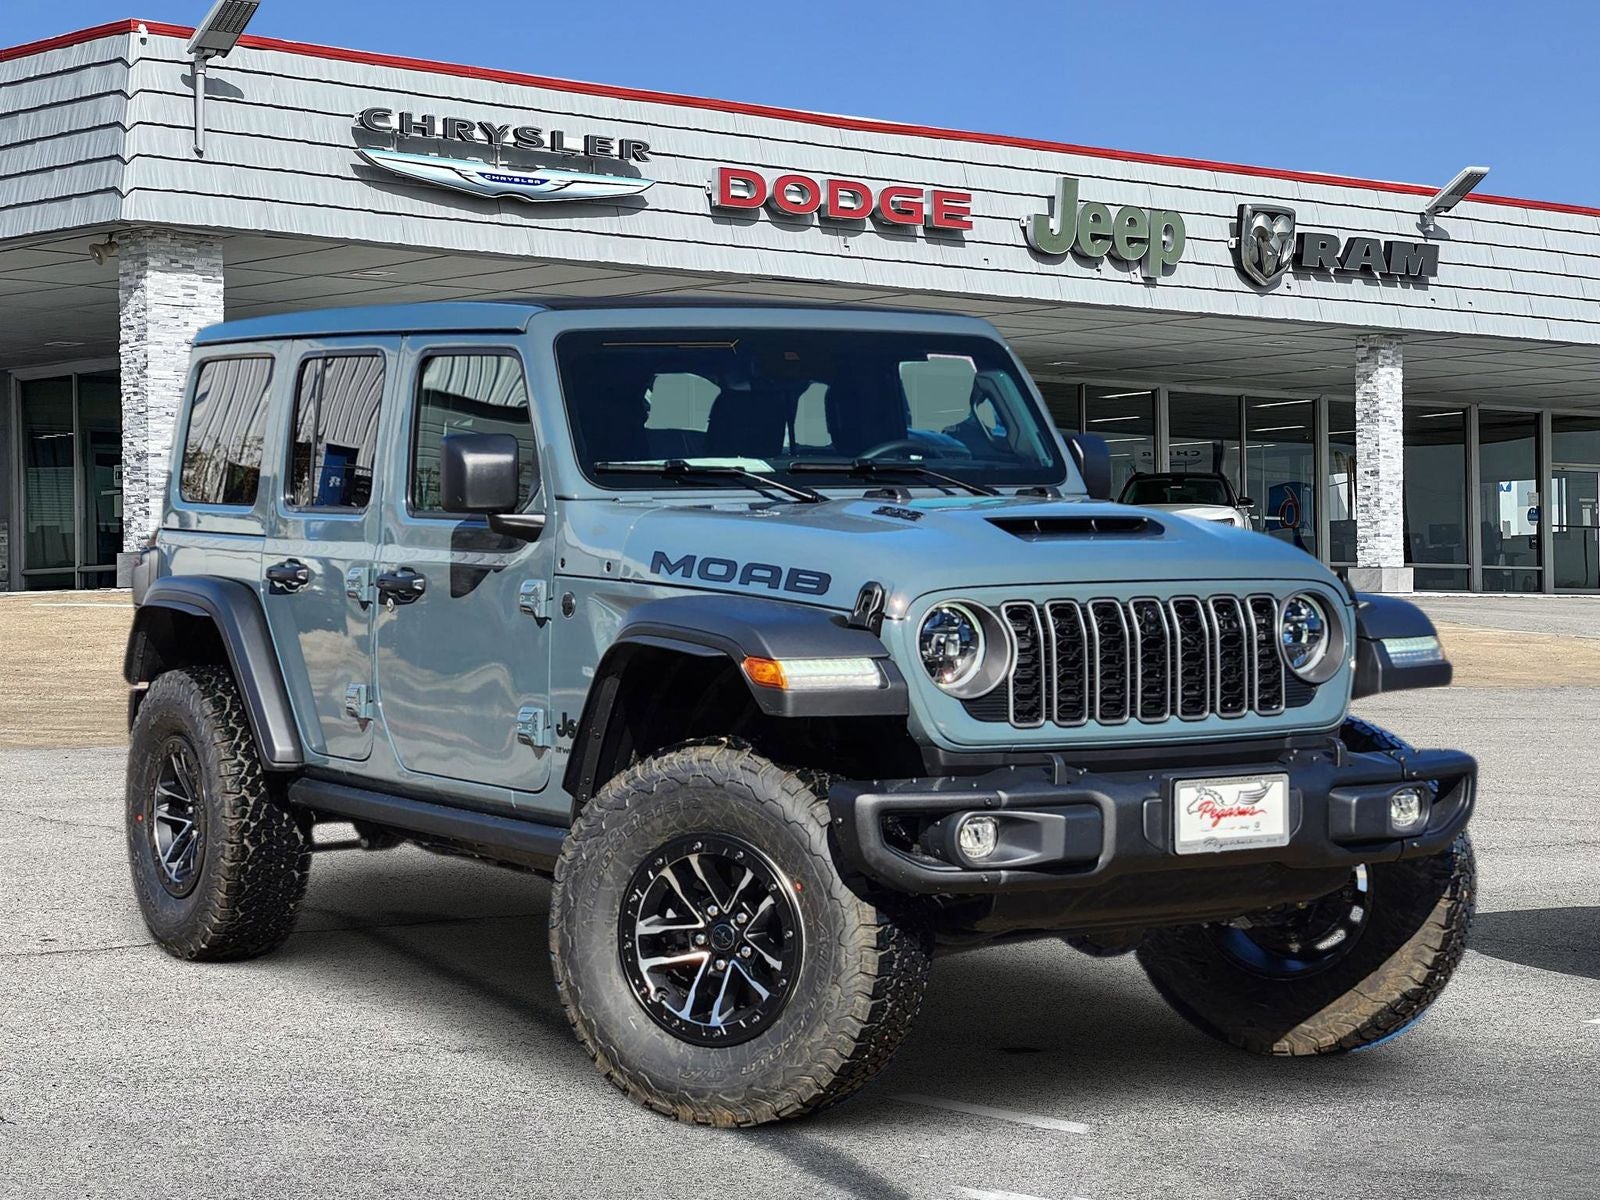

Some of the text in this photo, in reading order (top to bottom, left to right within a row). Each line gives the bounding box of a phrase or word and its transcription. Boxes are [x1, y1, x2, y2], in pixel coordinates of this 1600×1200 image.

[356, 106, 651, 163] CHRYSLER
[484, 174, 541, 185] CHRYSLER
[711, 166, 974, 231] DODGE
[1026, 176, 1187, 278] Jeep
[1299, 231, 1440, 278] RAM
[650, 550, 833, 596] MOAB
[1198, 799, 1267, 828] Pegasus
